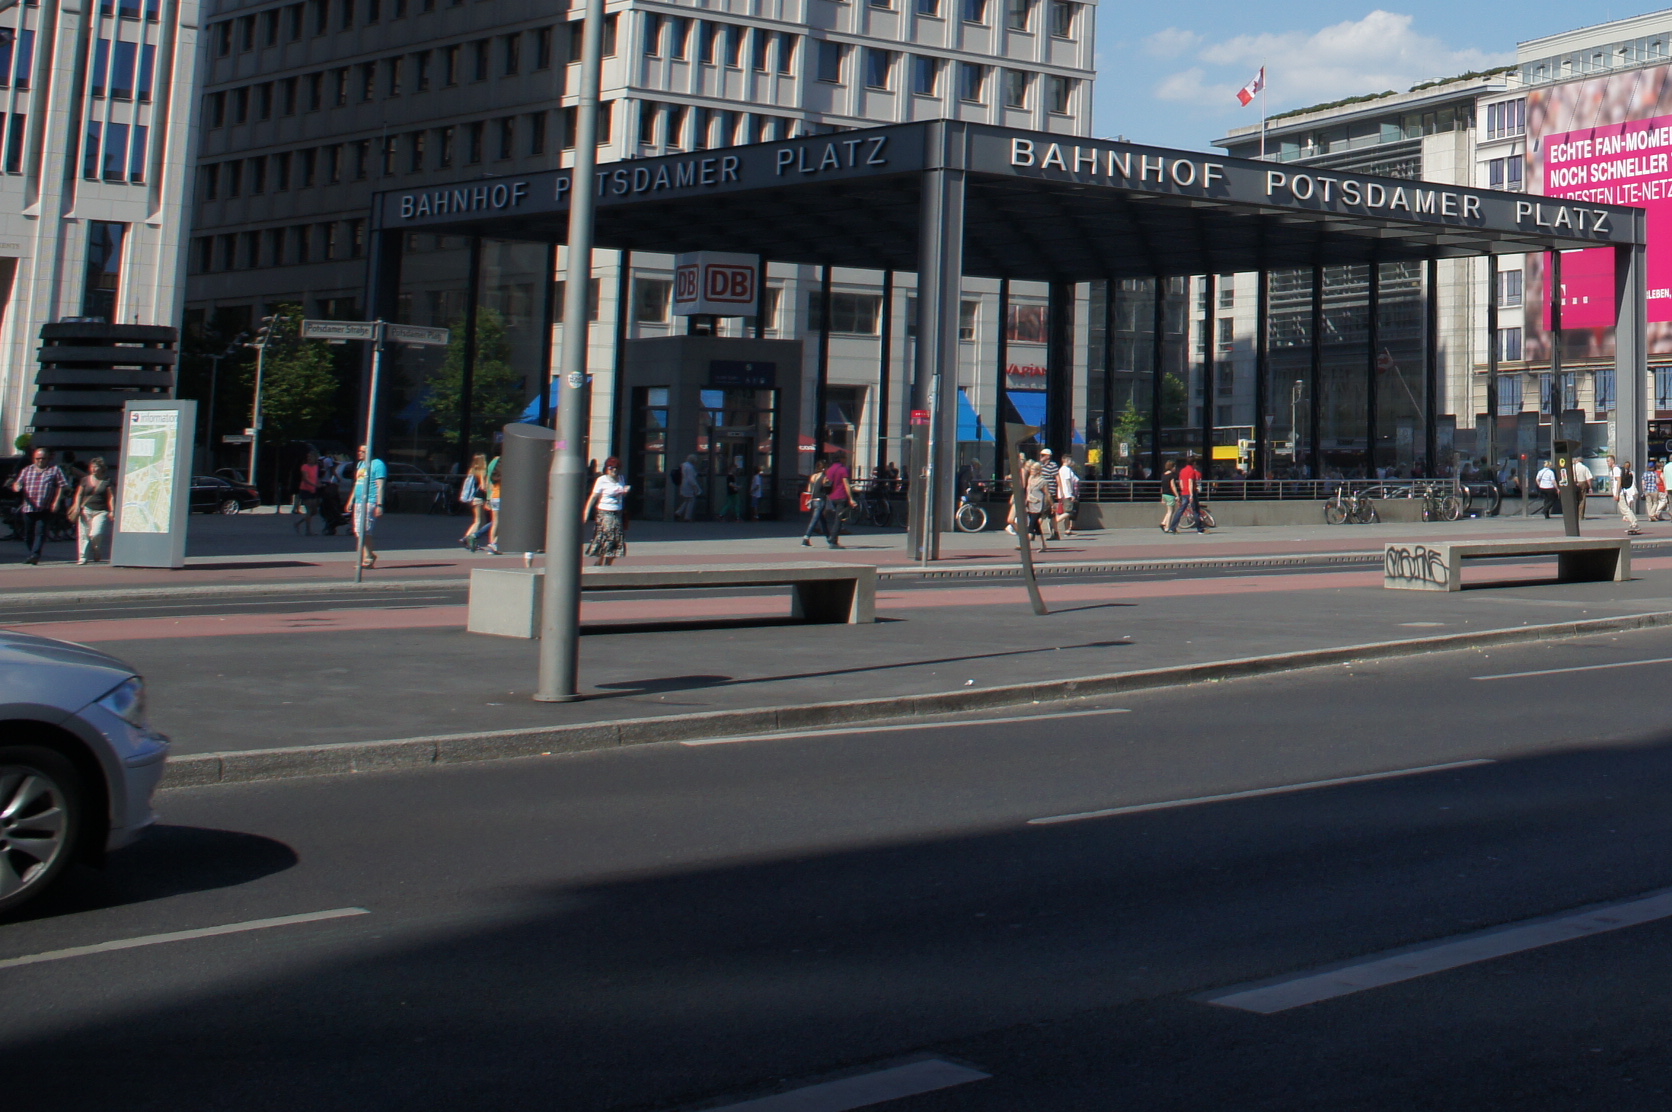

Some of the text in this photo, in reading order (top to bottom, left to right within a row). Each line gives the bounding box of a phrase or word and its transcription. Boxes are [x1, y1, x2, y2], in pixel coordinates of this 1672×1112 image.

[1550, 140, 1592, 164] ECHTE
[401, 136, 888, 218] BAHNHOF PTSDAMER PLATZ
[1550, 165, 1587, 188] NOCH
[1590, 153, 1669, 182] SCHNELLER
[1011, 137, 1609, 233] BAHNHOF POTSDAMER PLATZ
[678, 270, 696, 297] DB
[711, 270, 748, 296] DB
[140, 412, 177, 423] information
